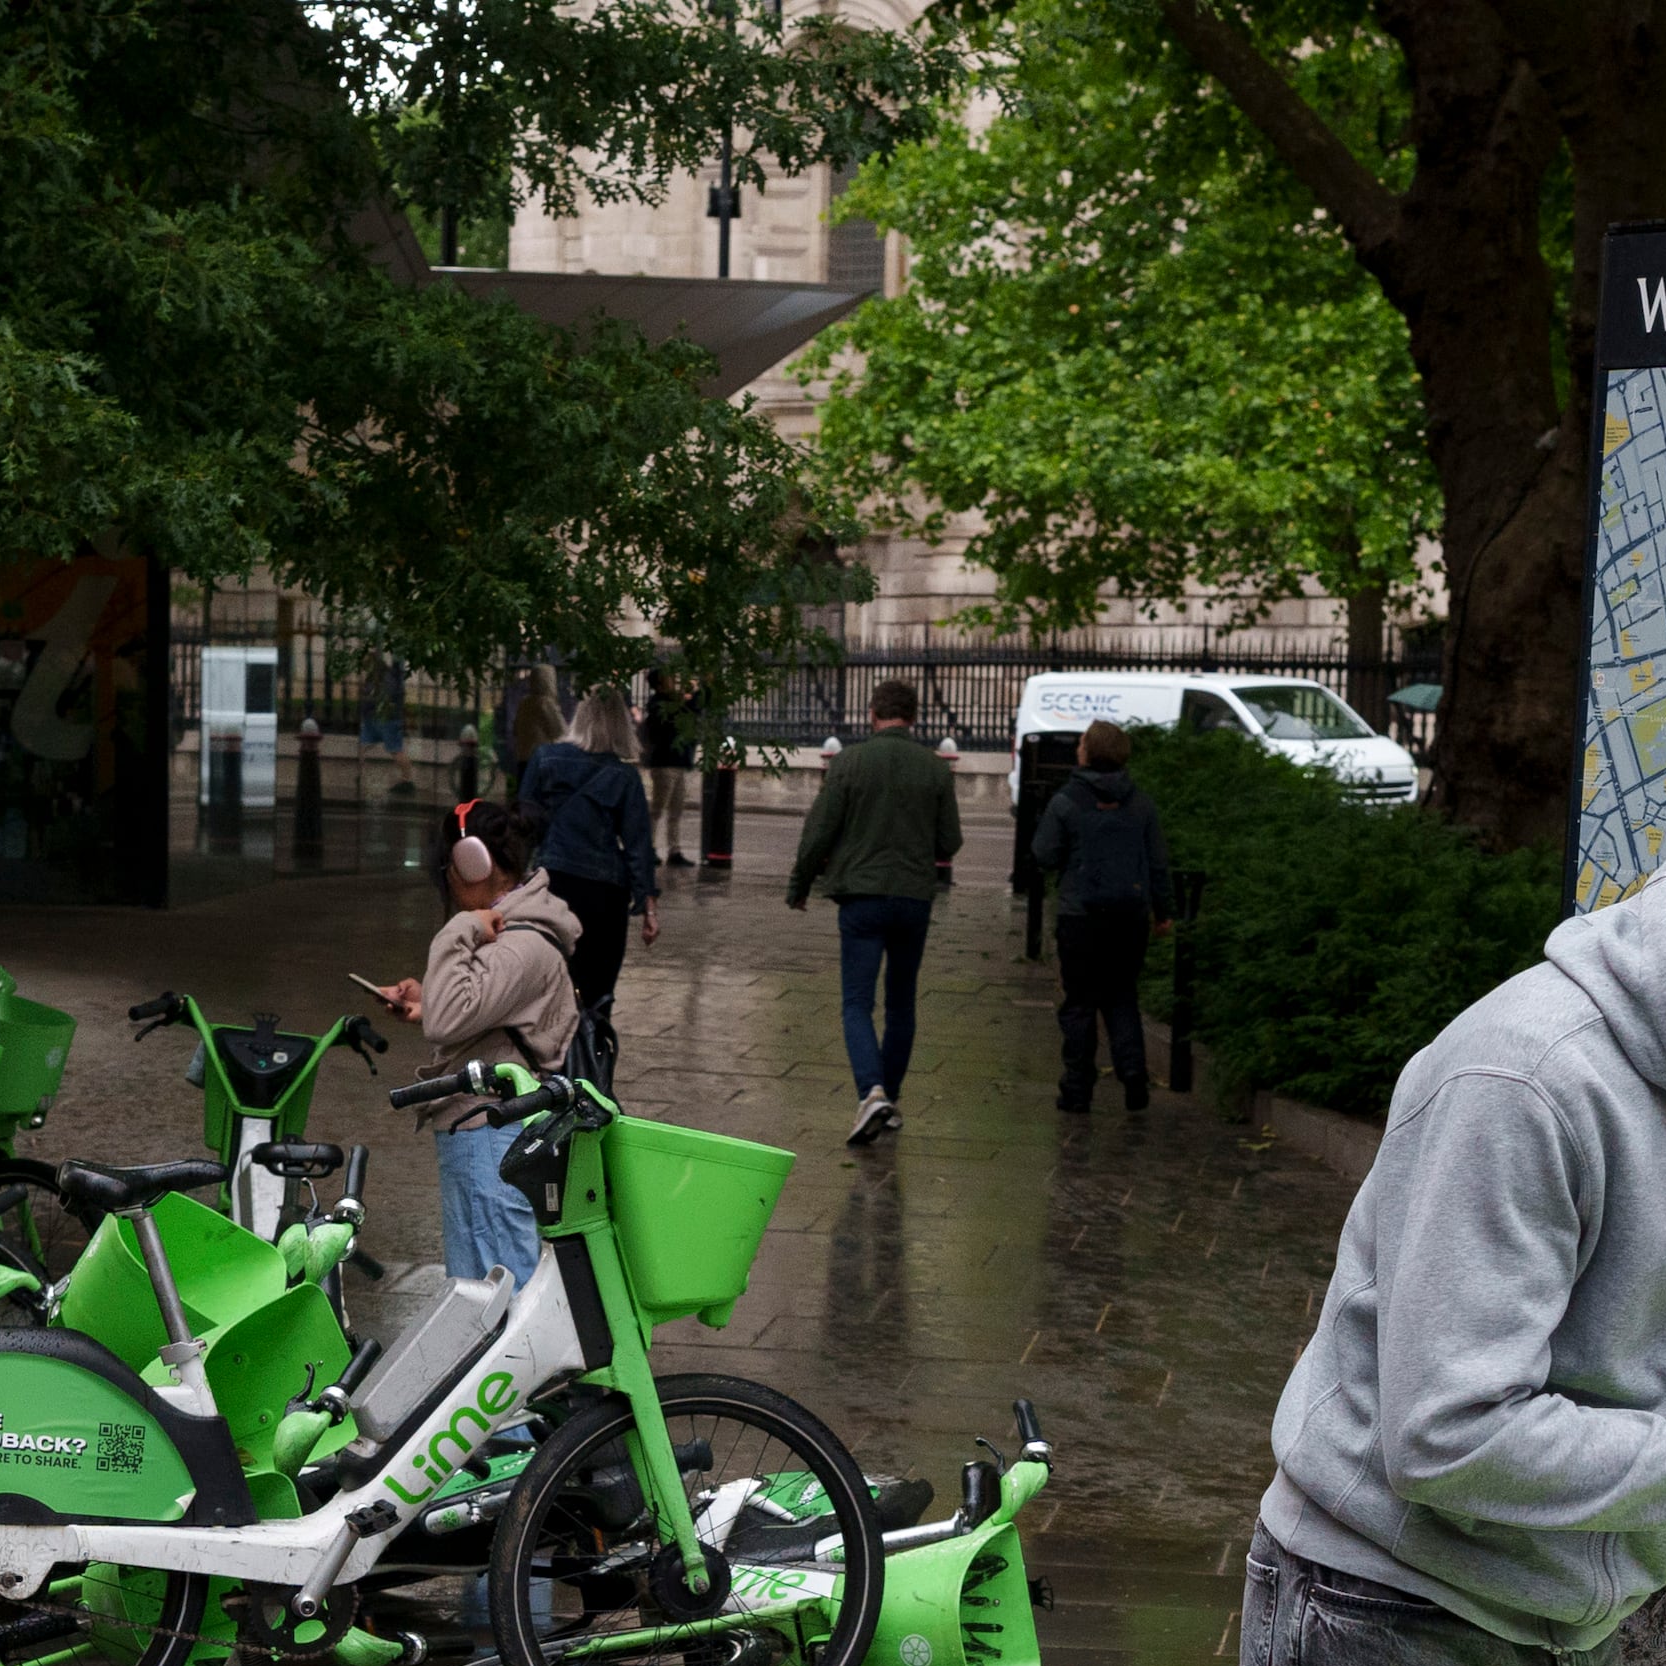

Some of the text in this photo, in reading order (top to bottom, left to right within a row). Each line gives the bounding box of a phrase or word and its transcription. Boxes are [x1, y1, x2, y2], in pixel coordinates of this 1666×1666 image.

[1040, 692, 1122, 713] SCENIC
[383, 1370, 521, 1506] Lime
[14, 1452, 32, 1466] TO
[35, 1453, 83, 1470] SHARE.
